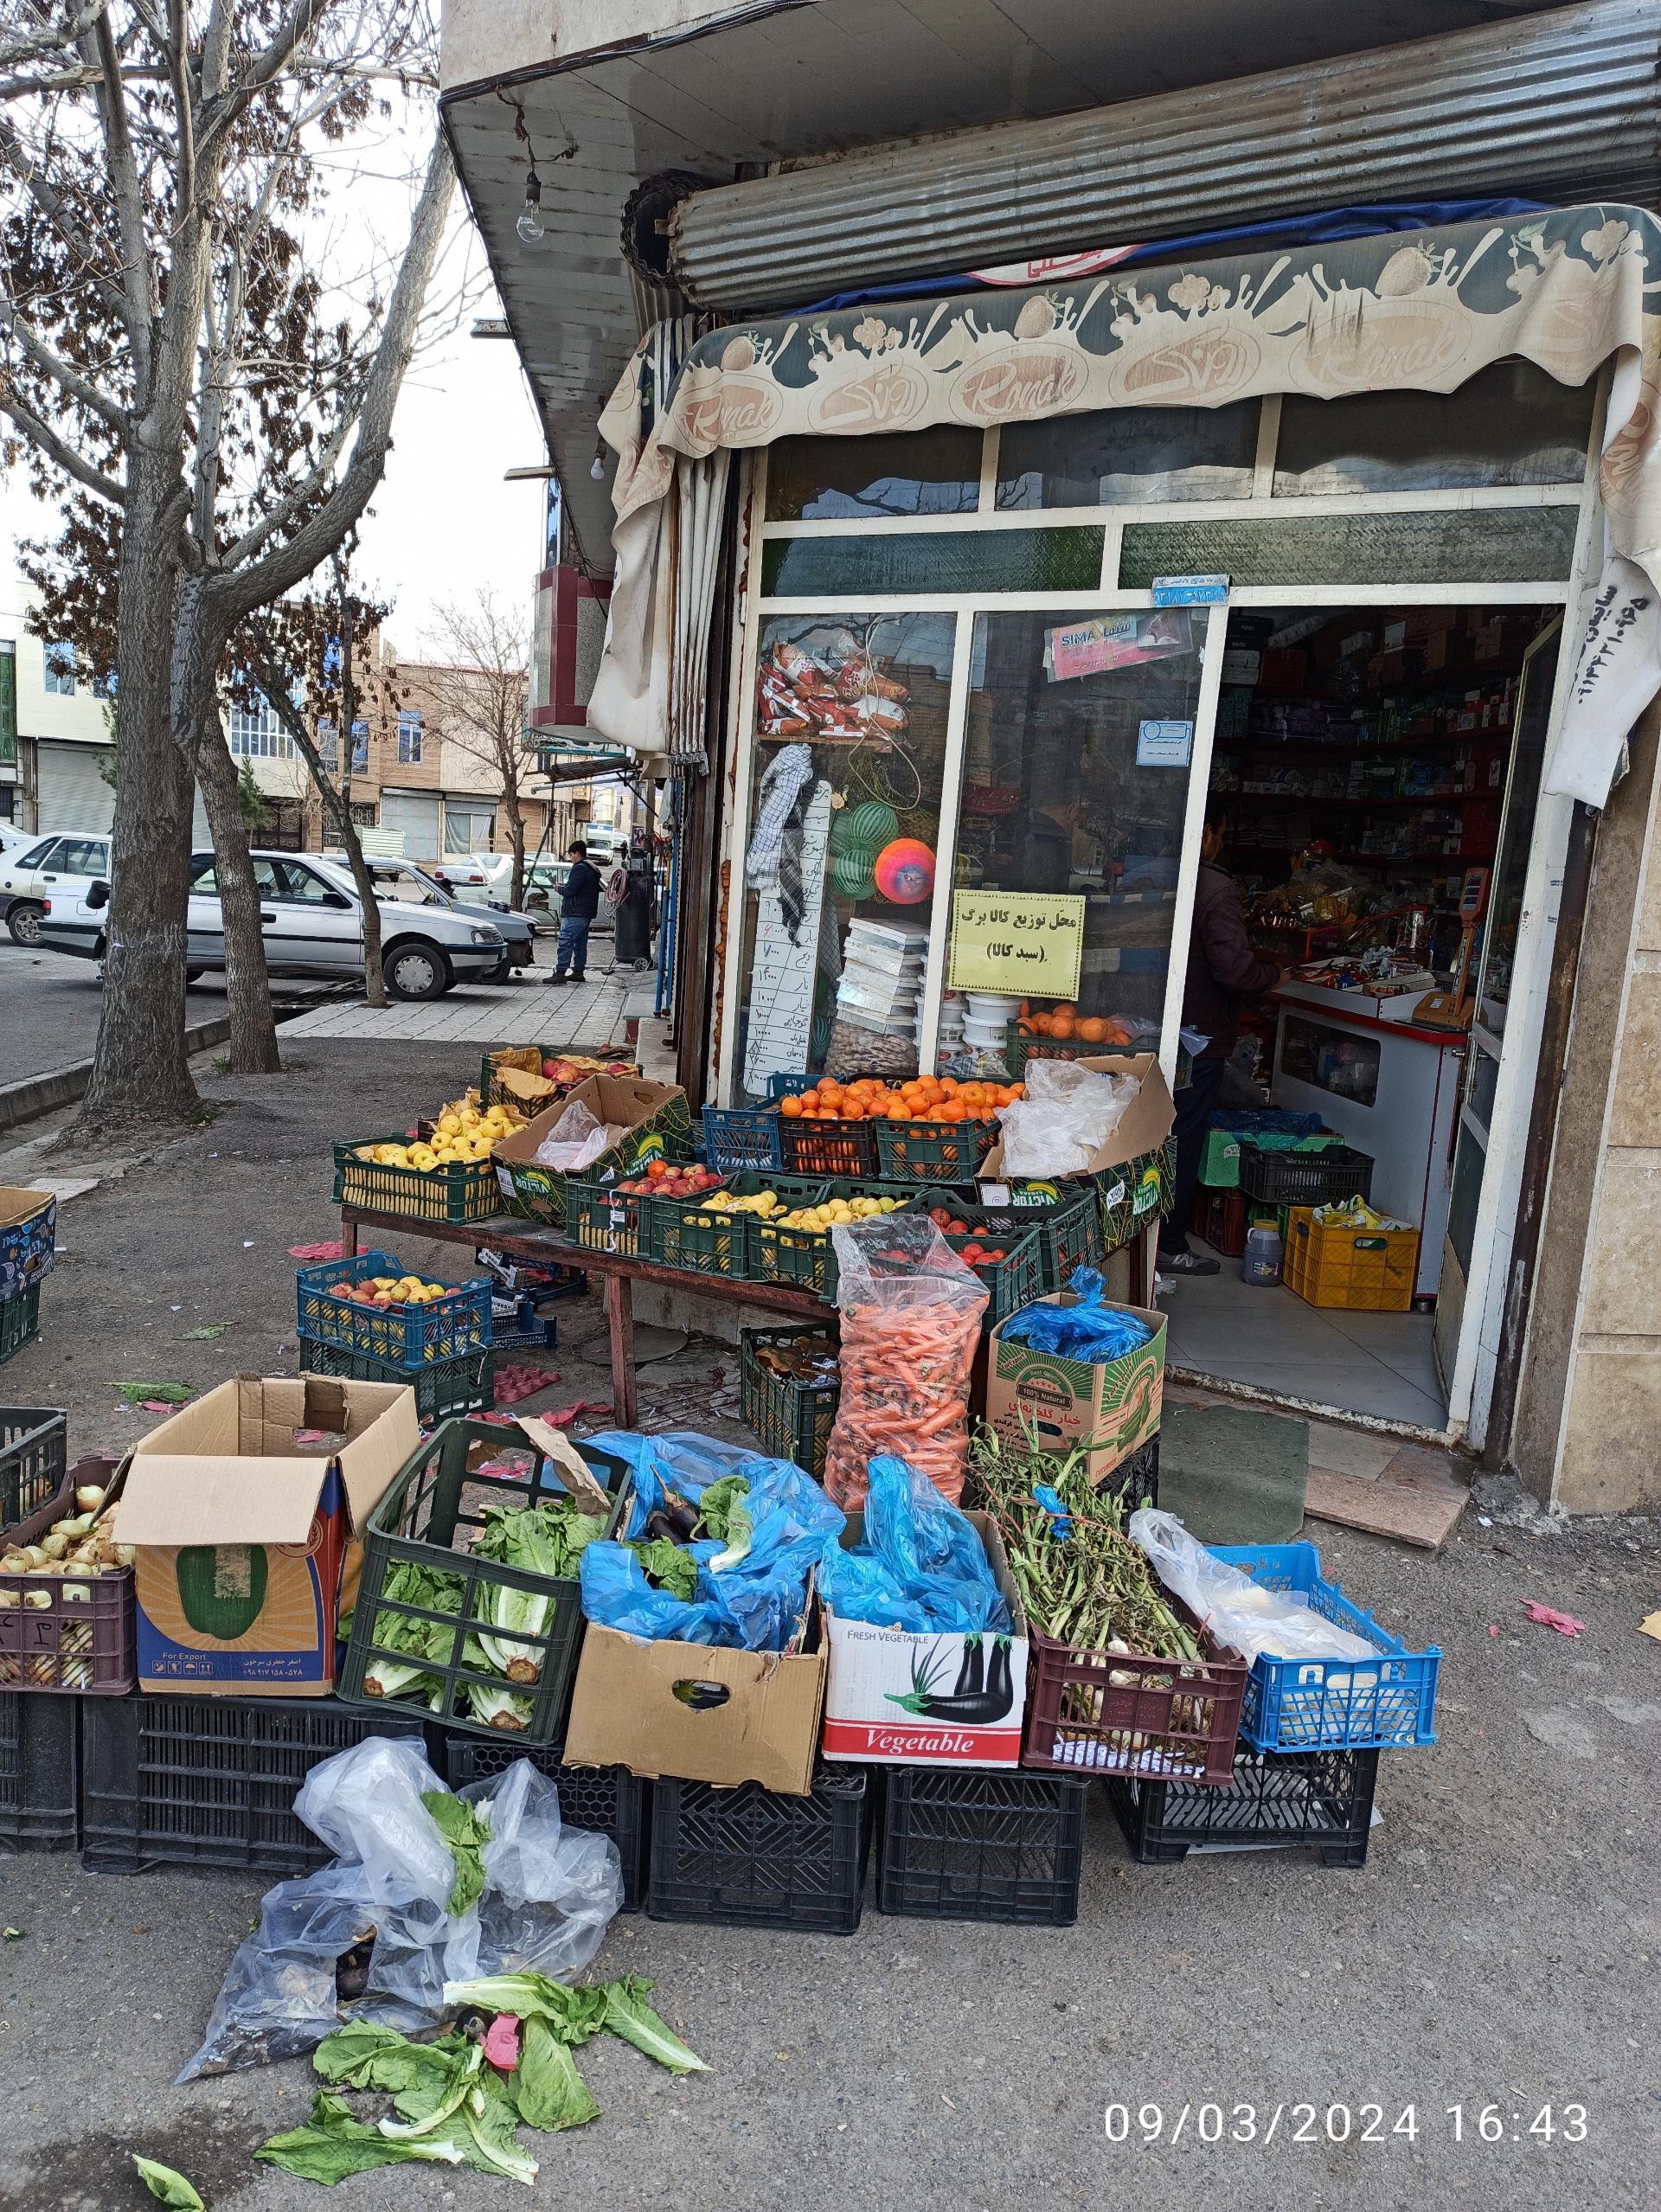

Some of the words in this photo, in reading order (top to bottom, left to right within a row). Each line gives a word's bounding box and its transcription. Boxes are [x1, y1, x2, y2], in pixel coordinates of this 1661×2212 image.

[960, 355, 1077, 415] Ronak
[684, 387, 773, 441] Rnak
[1061, 629, 1097, 646] SIMA
[1013, 913, 1046, 929] توزیع
[1023, 1388, 1039, 1398] 100%
[1041, 1393, 1066, 1405] Natural
[1057, 1413, 1081, 1427] خیار
[847, 1630, 876, 1641] FRESH
[878, 1632, 929, 1644] VEGETABLE
[178, 1652, 207, 1661] Export
[866, 1730, 974, 1754] Vegetable
